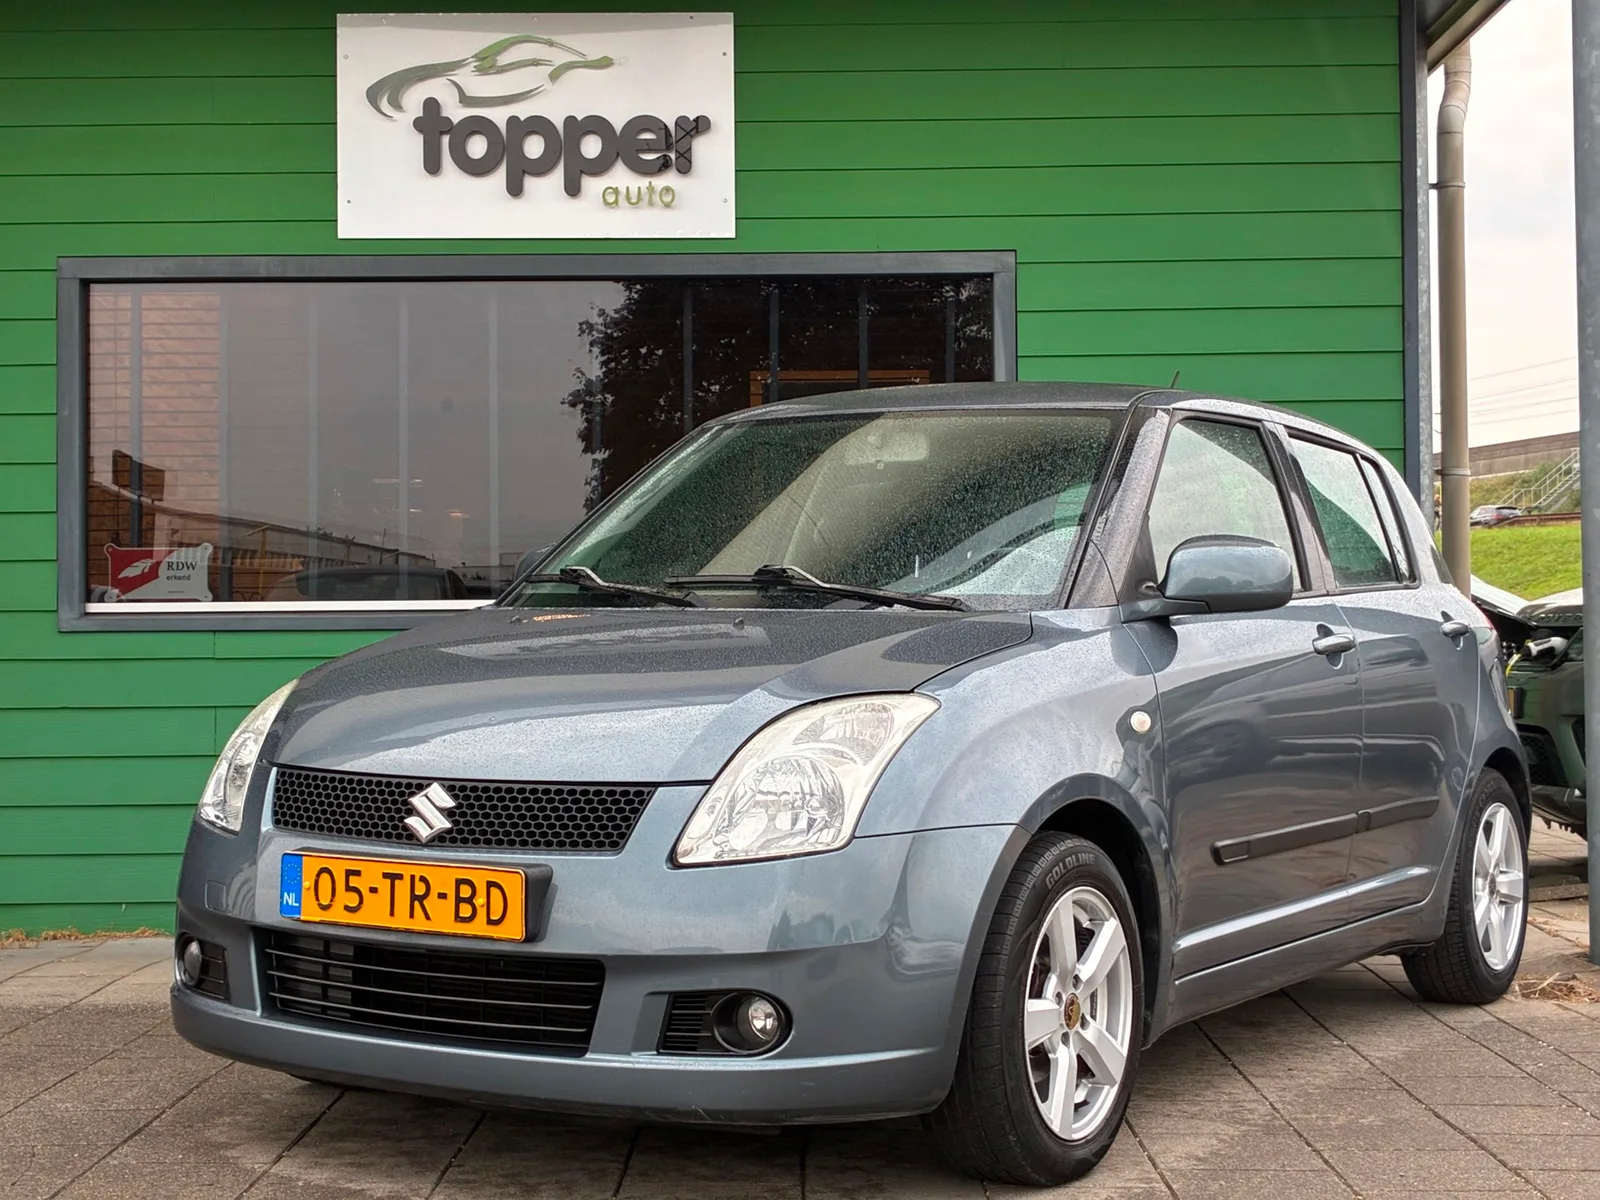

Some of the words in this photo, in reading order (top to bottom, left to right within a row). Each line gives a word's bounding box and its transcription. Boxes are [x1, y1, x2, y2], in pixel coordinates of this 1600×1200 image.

[412, 96, 711, 198] topper
[601, 180, 677, 208] auto
[166, 560, 198, 571] RDW
[1045, 852, 1096, 889] GOLDLINE
[283, 891, 300, 907] NL
[313, 866, 508, 926] 05-TR-BD
